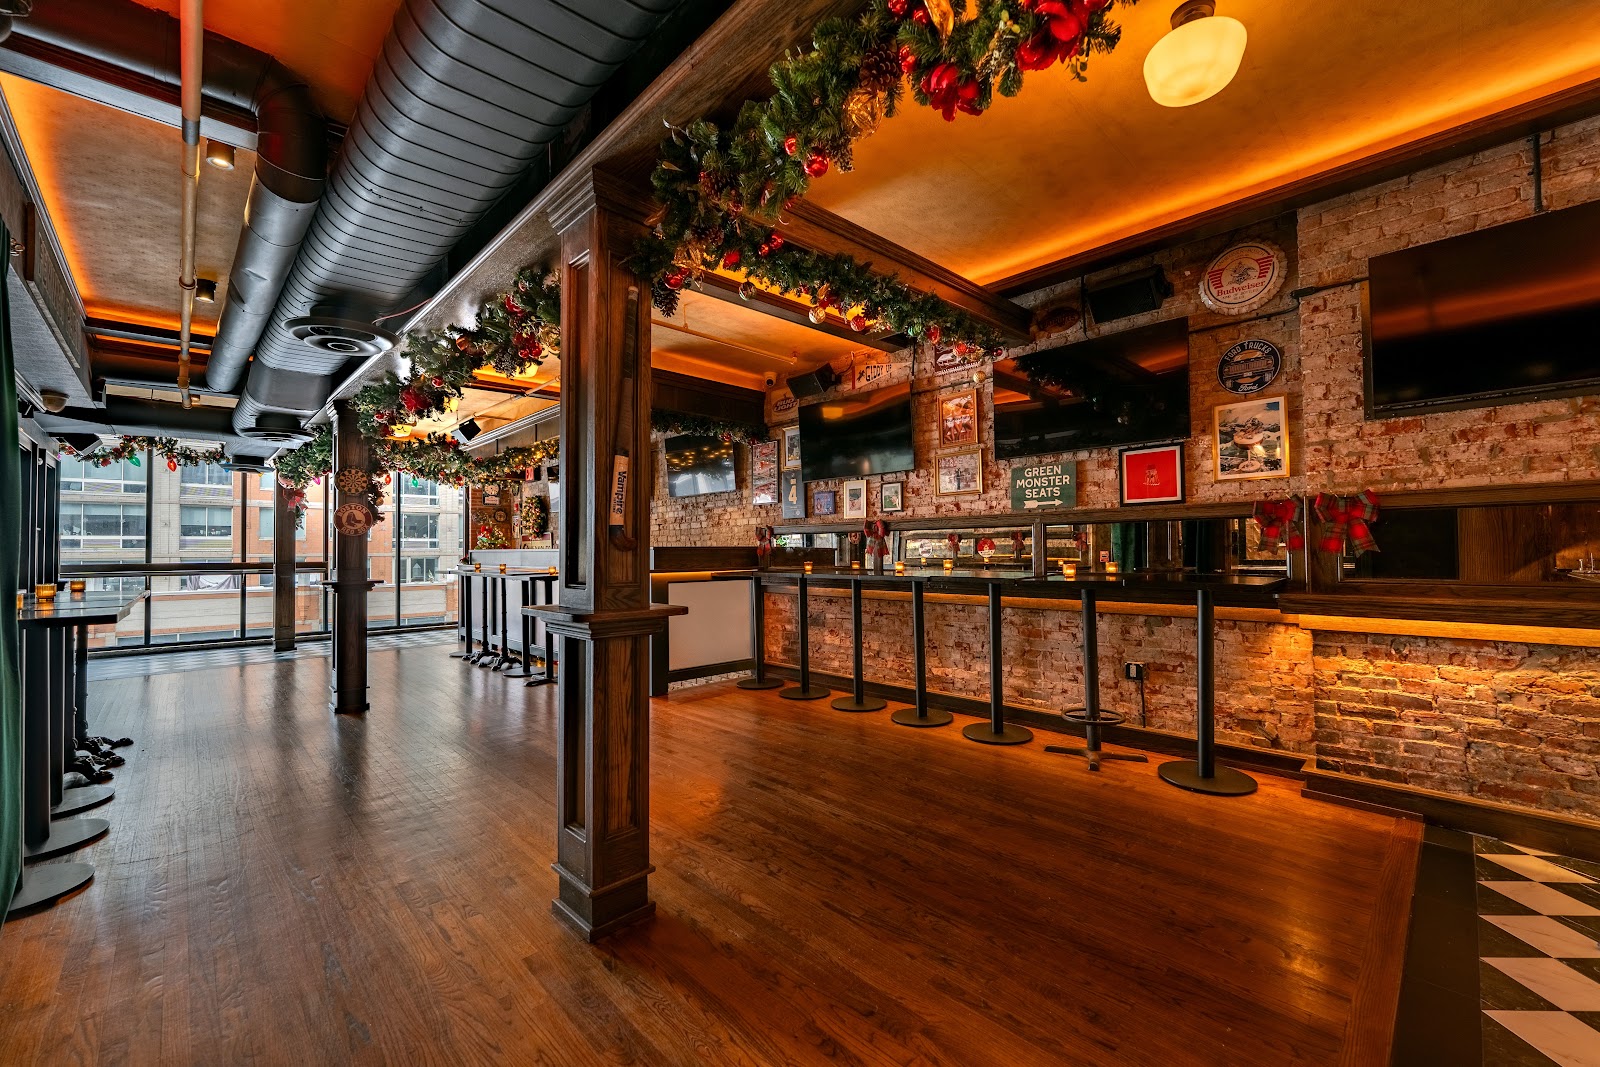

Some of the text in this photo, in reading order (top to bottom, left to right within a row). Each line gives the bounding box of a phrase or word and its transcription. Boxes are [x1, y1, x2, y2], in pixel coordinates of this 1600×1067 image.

[1216, 280, 1265, 296] Budweiser
[1224, 341, 1272, 361] FORD TRUCKS
[865, 364, 884, 382] GIDDY
[1237, 382, 1260, 392] Ford
[1024, 464, 1062, 478] GREEN
[1016, 474, 1070, 489] MONSTER
[615, 470, 627, 515] Vampire
[1025, 486, 1061, 499] SEATS
[337, 505, 368, 517] BOSTON
[341, 526, 355, 535] RED
